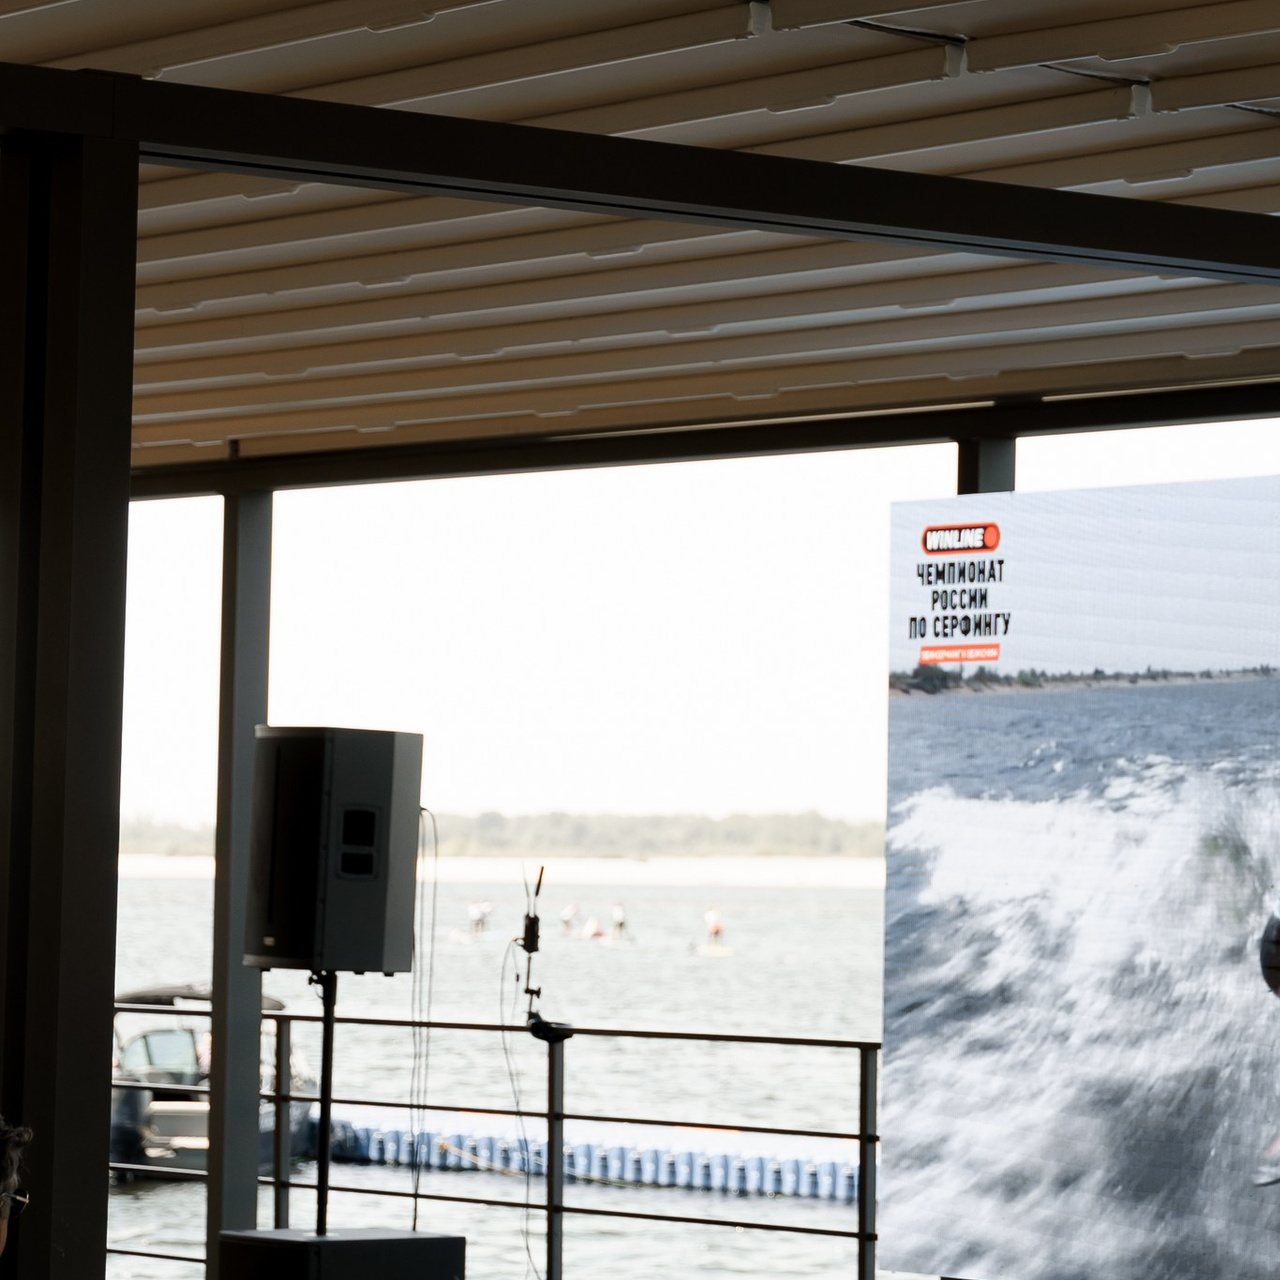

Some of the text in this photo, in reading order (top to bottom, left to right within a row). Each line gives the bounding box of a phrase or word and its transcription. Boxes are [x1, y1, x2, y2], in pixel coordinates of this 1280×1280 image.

[926, 528, 985, 550] WINLINE
[916, 559, 1005, 586] ЧЕМПИОНАТ
[931, 588, 989, 611] РОССИИ
[909, 612, 1011, 639] ПО СЕРФИНГУ
